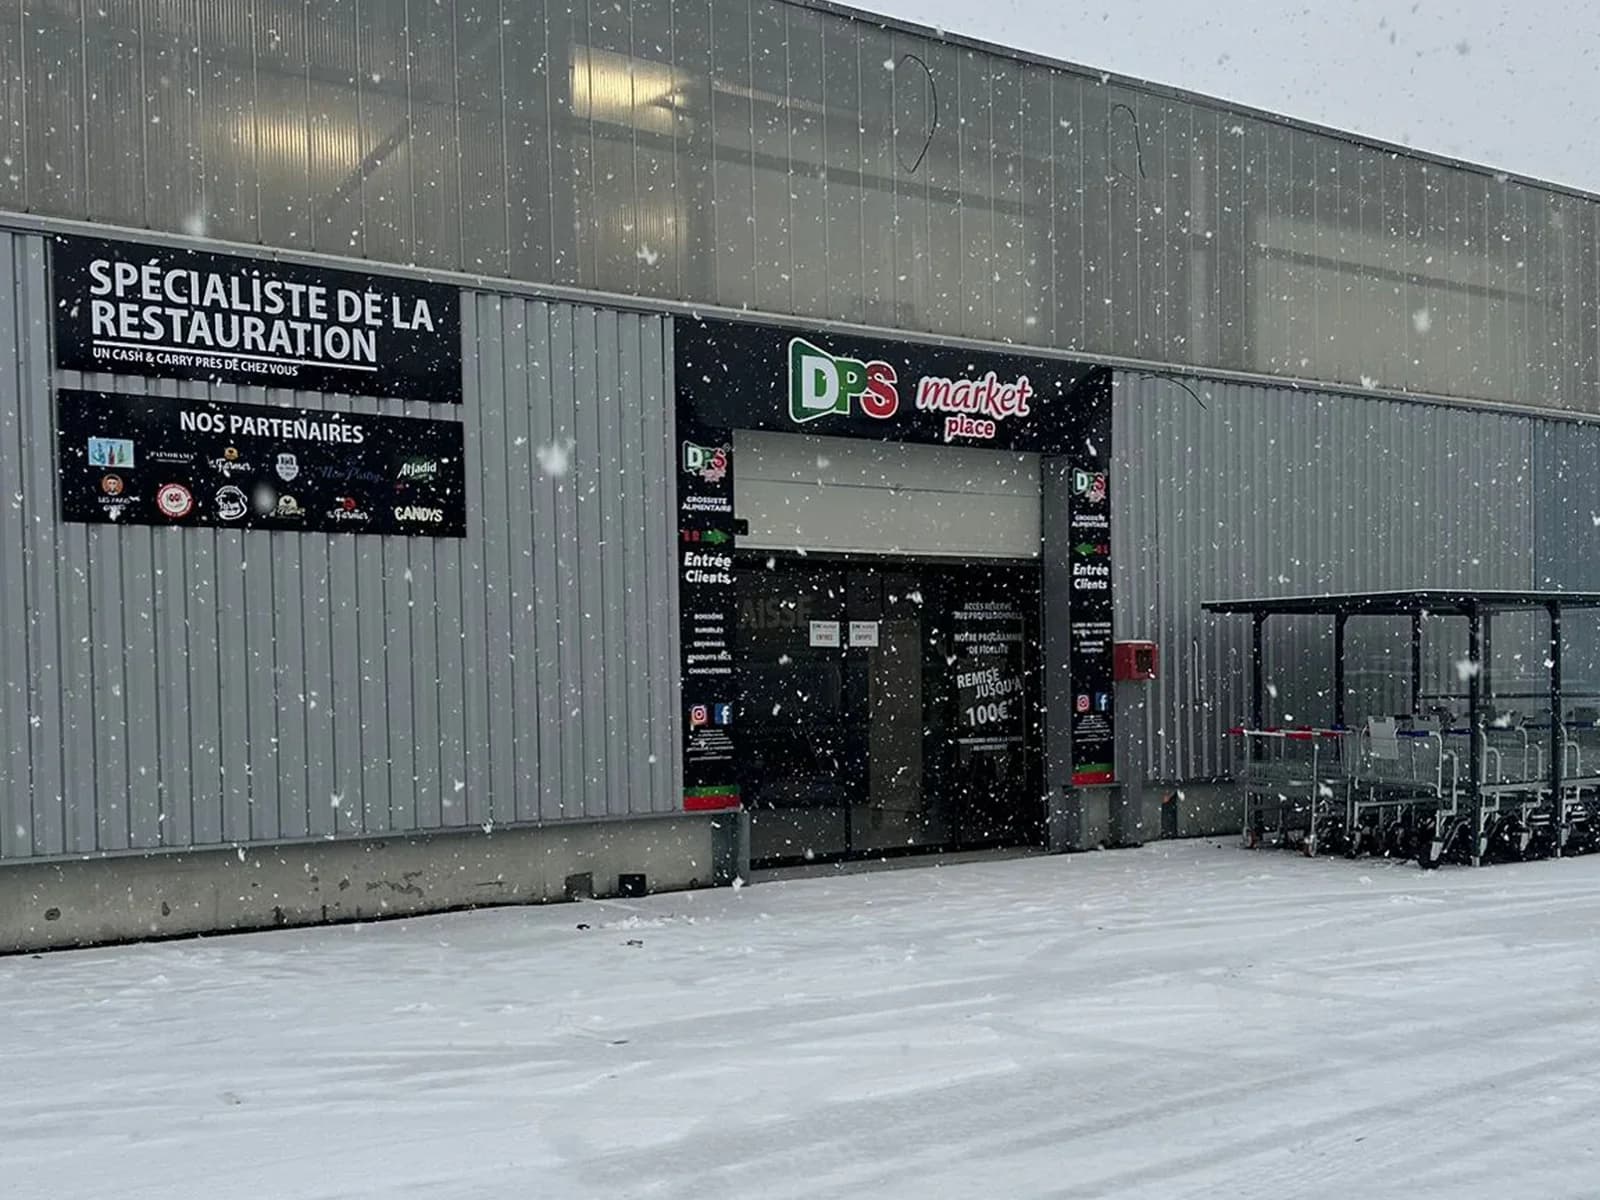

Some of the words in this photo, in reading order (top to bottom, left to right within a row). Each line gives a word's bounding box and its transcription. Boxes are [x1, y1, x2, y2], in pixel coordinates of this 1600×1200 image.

[90, 258, 328, 320] SPÉCIALISTE
[337, 288, 383, 326] DE
[393, 296, 434, 332] LA
[92, 300, 377, 363] RESTAURATION
[93, 347, 110, 359] UN
[112, 349, 143, 362] CASH
[145, 352, 155, 363] &
[157, 353, 193, 366] CARRY
[225, 358, 240, 371] DE
[241, 361, 268, 373] CHEZ
[270, 364, 298, 376] VOUS
[792, 340, 899, 421] DPS
[917, 371, 1032, 418] market
[179, 410, 225, 434] NOS
[230, 413, 365, 444] PARTENAIRES
[945, 416, 997, 441] place
[684, 552, 732, 568] Entrée
[1073, 563, 1109, 576] Entrée
[685, 570, 731, 584] Clients
[1074, 579, 1108, 589] Clients
[957, 668, 1000, 689] REMISE
